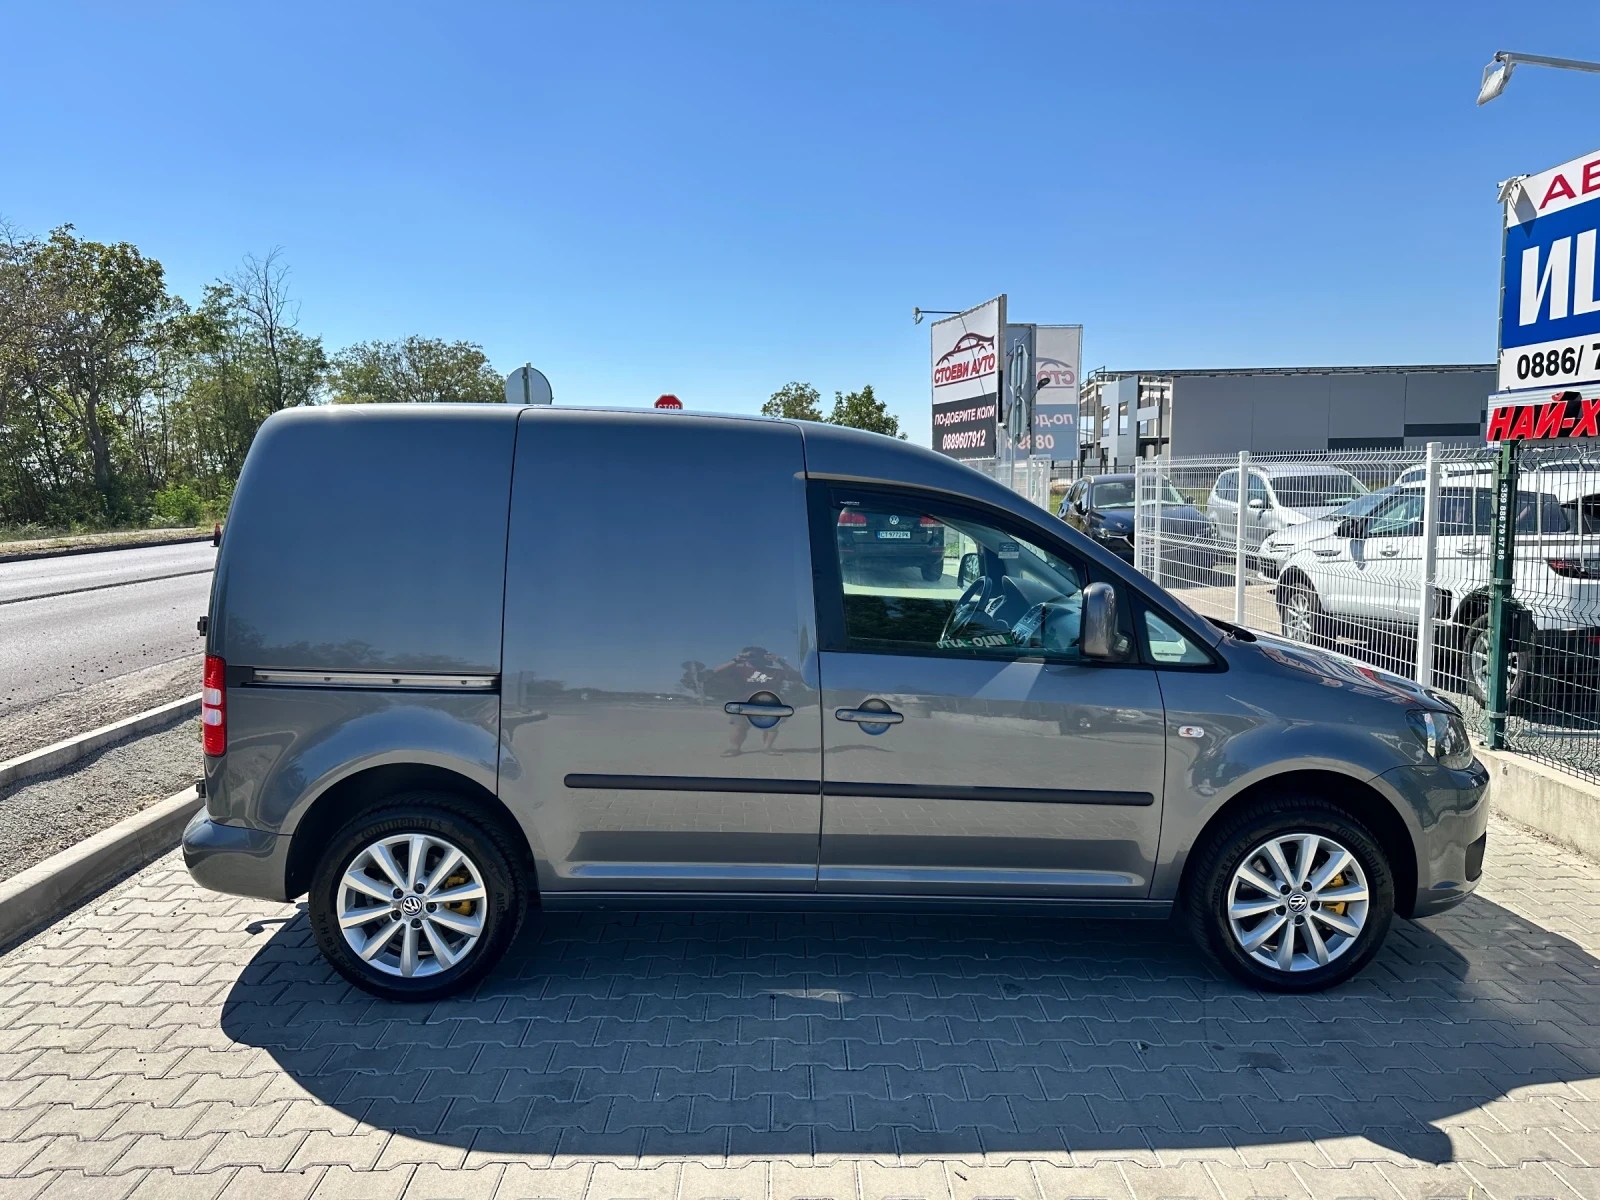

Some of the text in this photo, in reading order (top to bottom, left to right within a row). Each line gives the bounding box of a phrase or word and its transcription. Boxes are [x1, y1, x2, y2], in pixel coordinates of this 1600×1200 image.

[934, 353, 995, 384] СТОЕВИ АУТО
[1517, 344, 1584, 380] 0886/
[934, 404, 995, 427] ПО-ДОБРИТЕ КОЛИ
[942, 429, 986, 450] 0889607912
